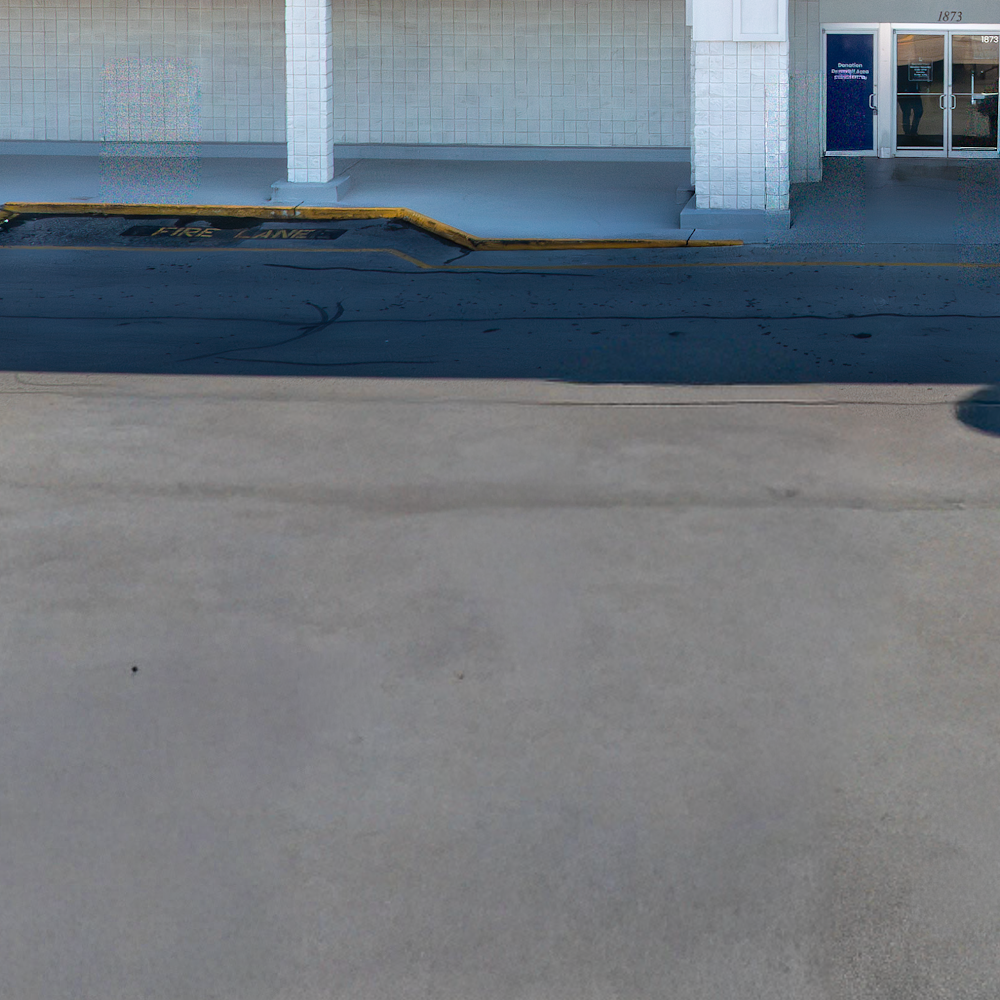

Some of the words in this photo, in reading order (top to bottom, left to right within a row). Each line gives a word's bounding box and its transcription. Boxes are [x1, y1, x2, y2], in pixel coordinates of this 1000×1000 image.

[937, 11, 963, 22] 1873
[151, 226, 221, 238] FIRE
[233, 228, 315, 240] LANE
